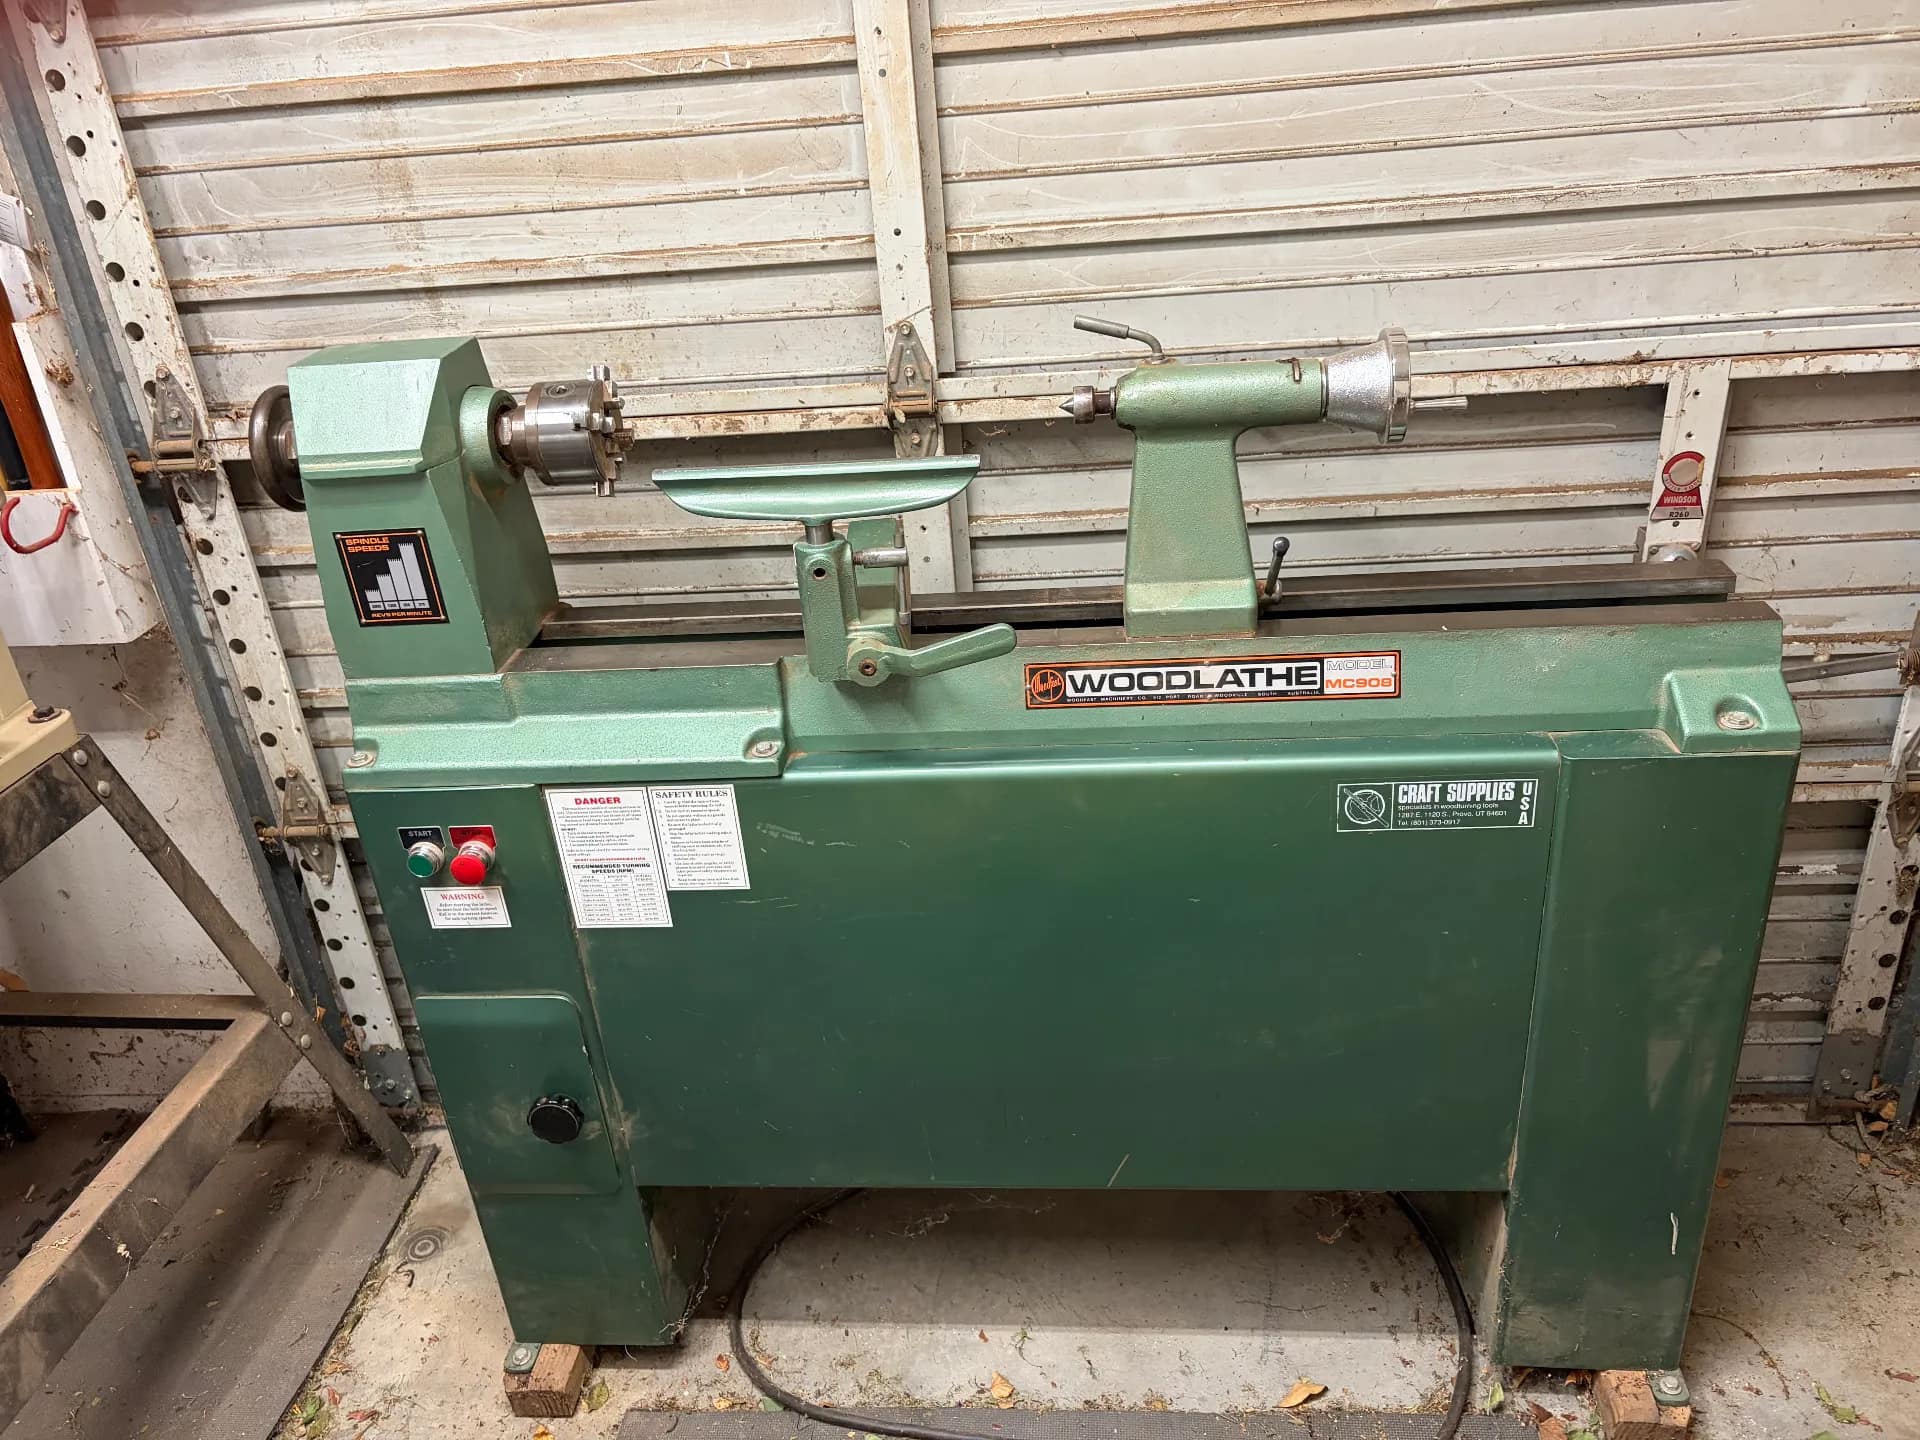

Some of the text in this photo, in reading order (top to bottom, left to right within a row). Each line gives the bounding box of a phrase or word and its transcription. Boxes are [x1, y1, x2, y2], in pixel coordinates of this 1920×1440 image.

[1663, 495, 1698, 504] WINDSOR
[345, 537, 390, 546] SPINDLE
[347, 544, 390, 553] SPEEDS
[1326, 658, 1393, 672] MODEL
[1068, 665, 1318, 694] WOODLATHE
[1325, 677, 1393, 689] MC908
[655, 789, 728, 799] SAFETY RULES
[1398, 781, 1516, 803] CRAFT SUPPLIES
[574, 796, 621, 805] DANGER
[440, 892, 485, 901] WARNING
